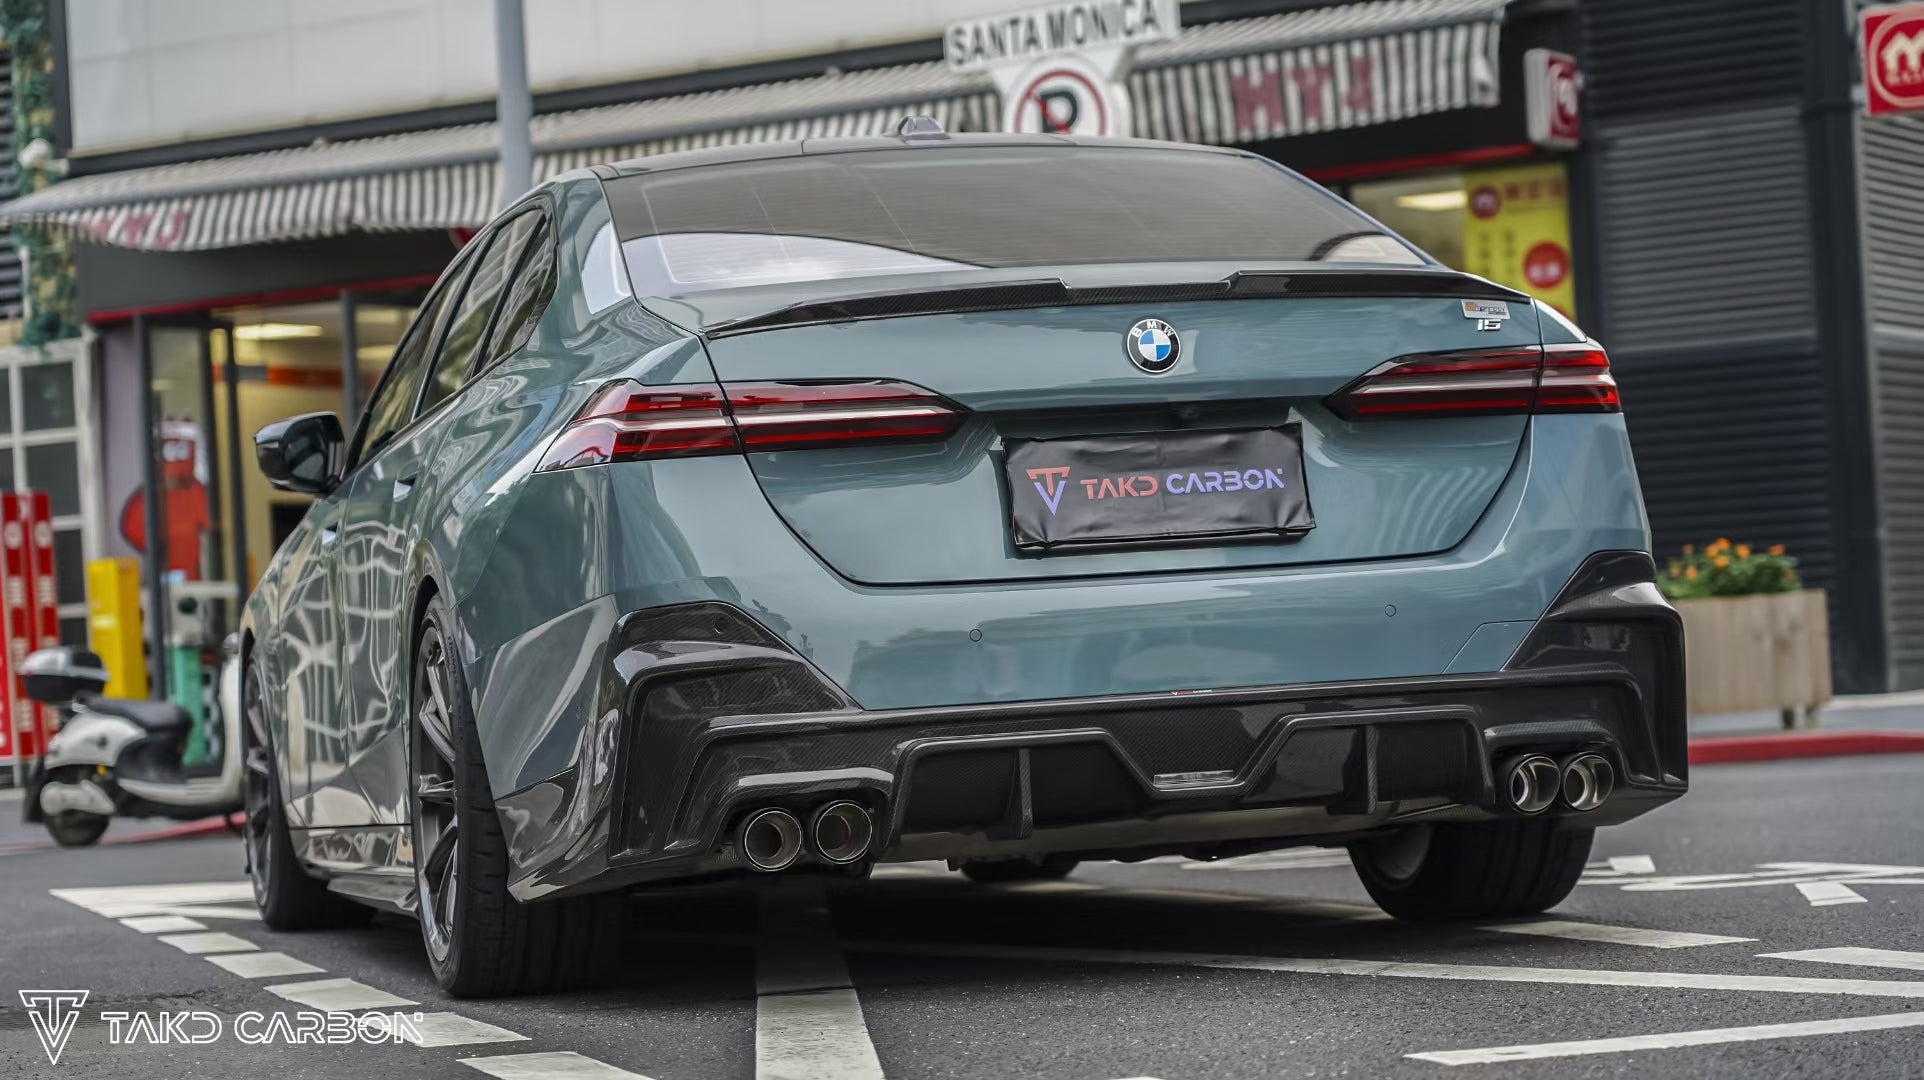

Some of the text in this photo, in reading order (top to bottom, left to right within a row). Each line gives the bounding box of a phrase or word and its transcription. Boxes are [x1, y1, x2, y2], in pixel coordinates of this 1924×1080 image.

[949, 0, 1161, 66] SANTA MONICA
[1231, 58, 1372, 129] MYJ
[1131, 320, 1174, 338] BMW
[1477, 319, 1502, 331] i5
[1080, 467, 1285, 500] TAKD CARBON
